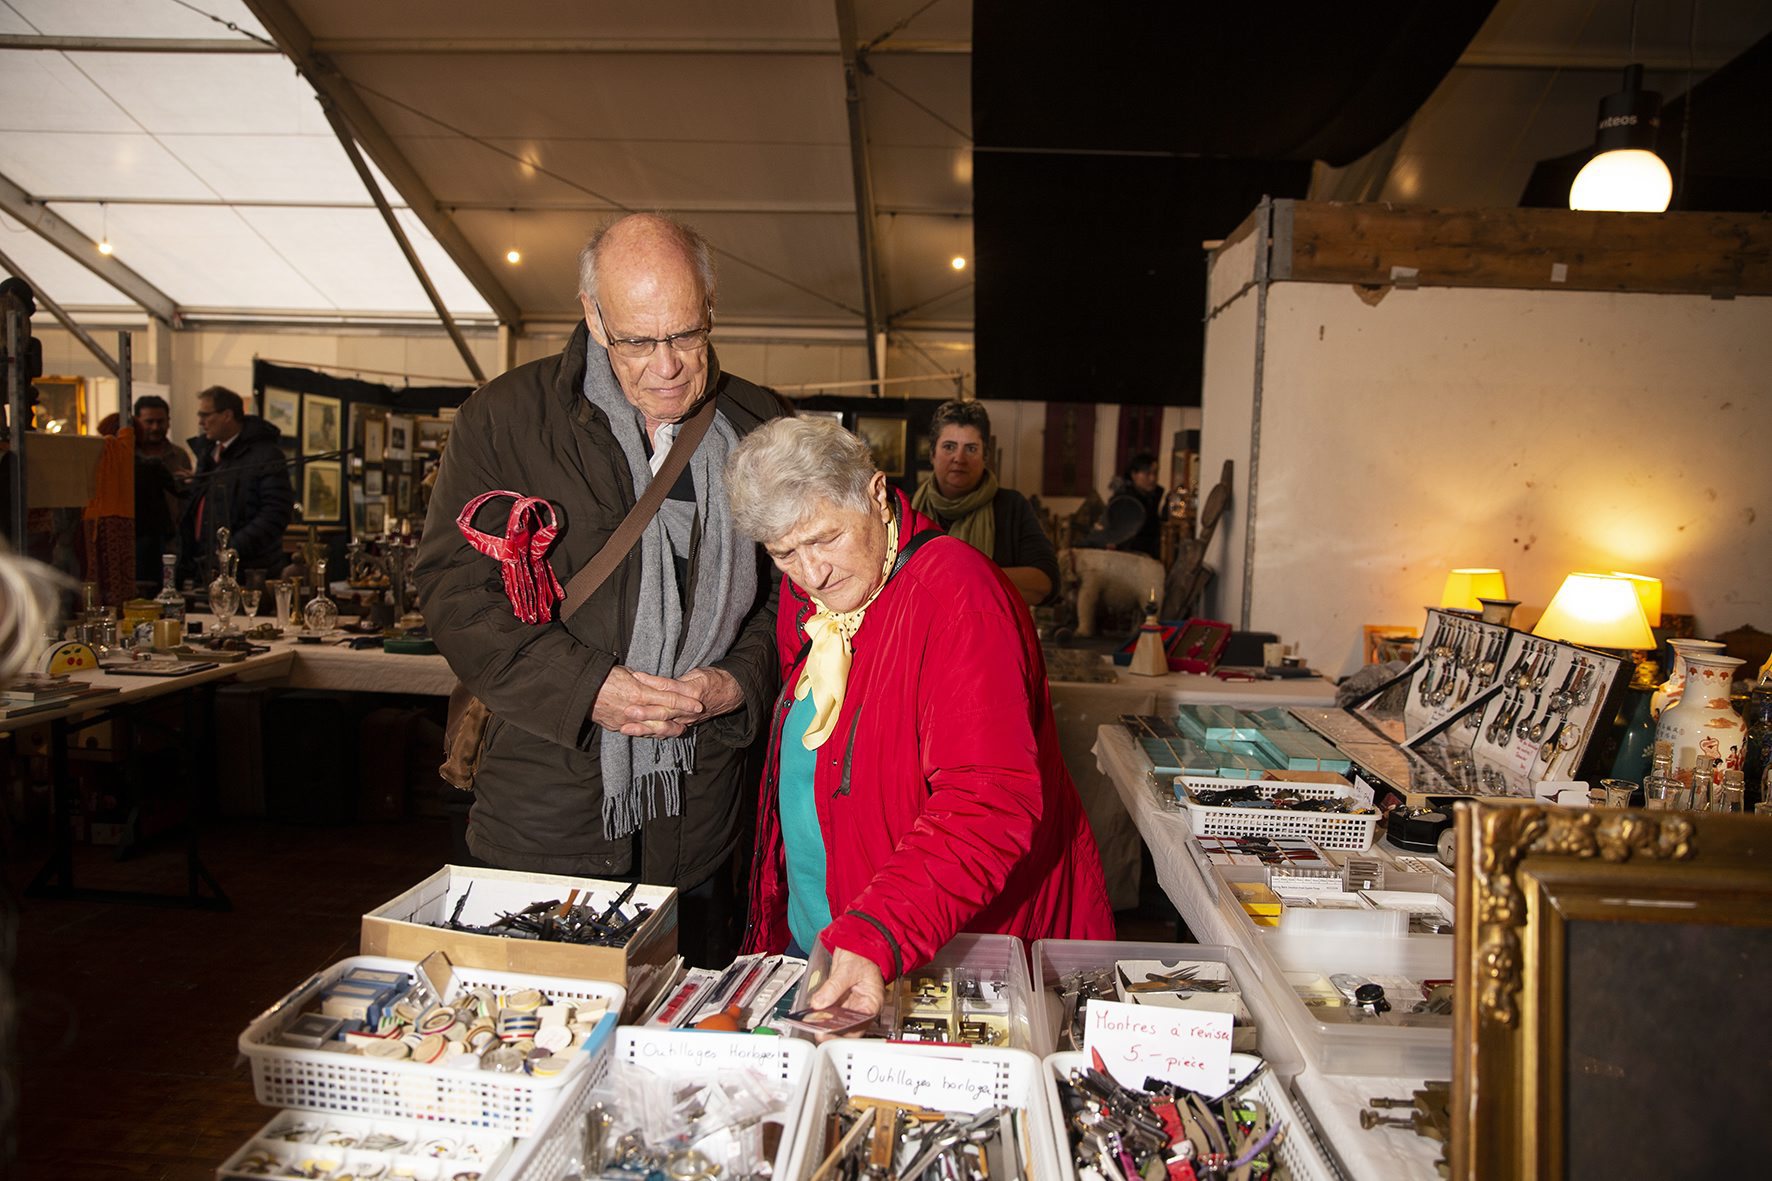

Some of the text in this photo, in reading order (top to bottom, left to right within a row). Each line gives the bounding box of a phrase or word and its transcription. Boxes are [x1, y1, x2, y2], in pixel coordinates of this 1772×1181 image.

[1095, 1009, 1156, 1036] Montres
[642, 1041, 717, 1066] Outillages
[867, 1065, 931, 1095] Outillages
